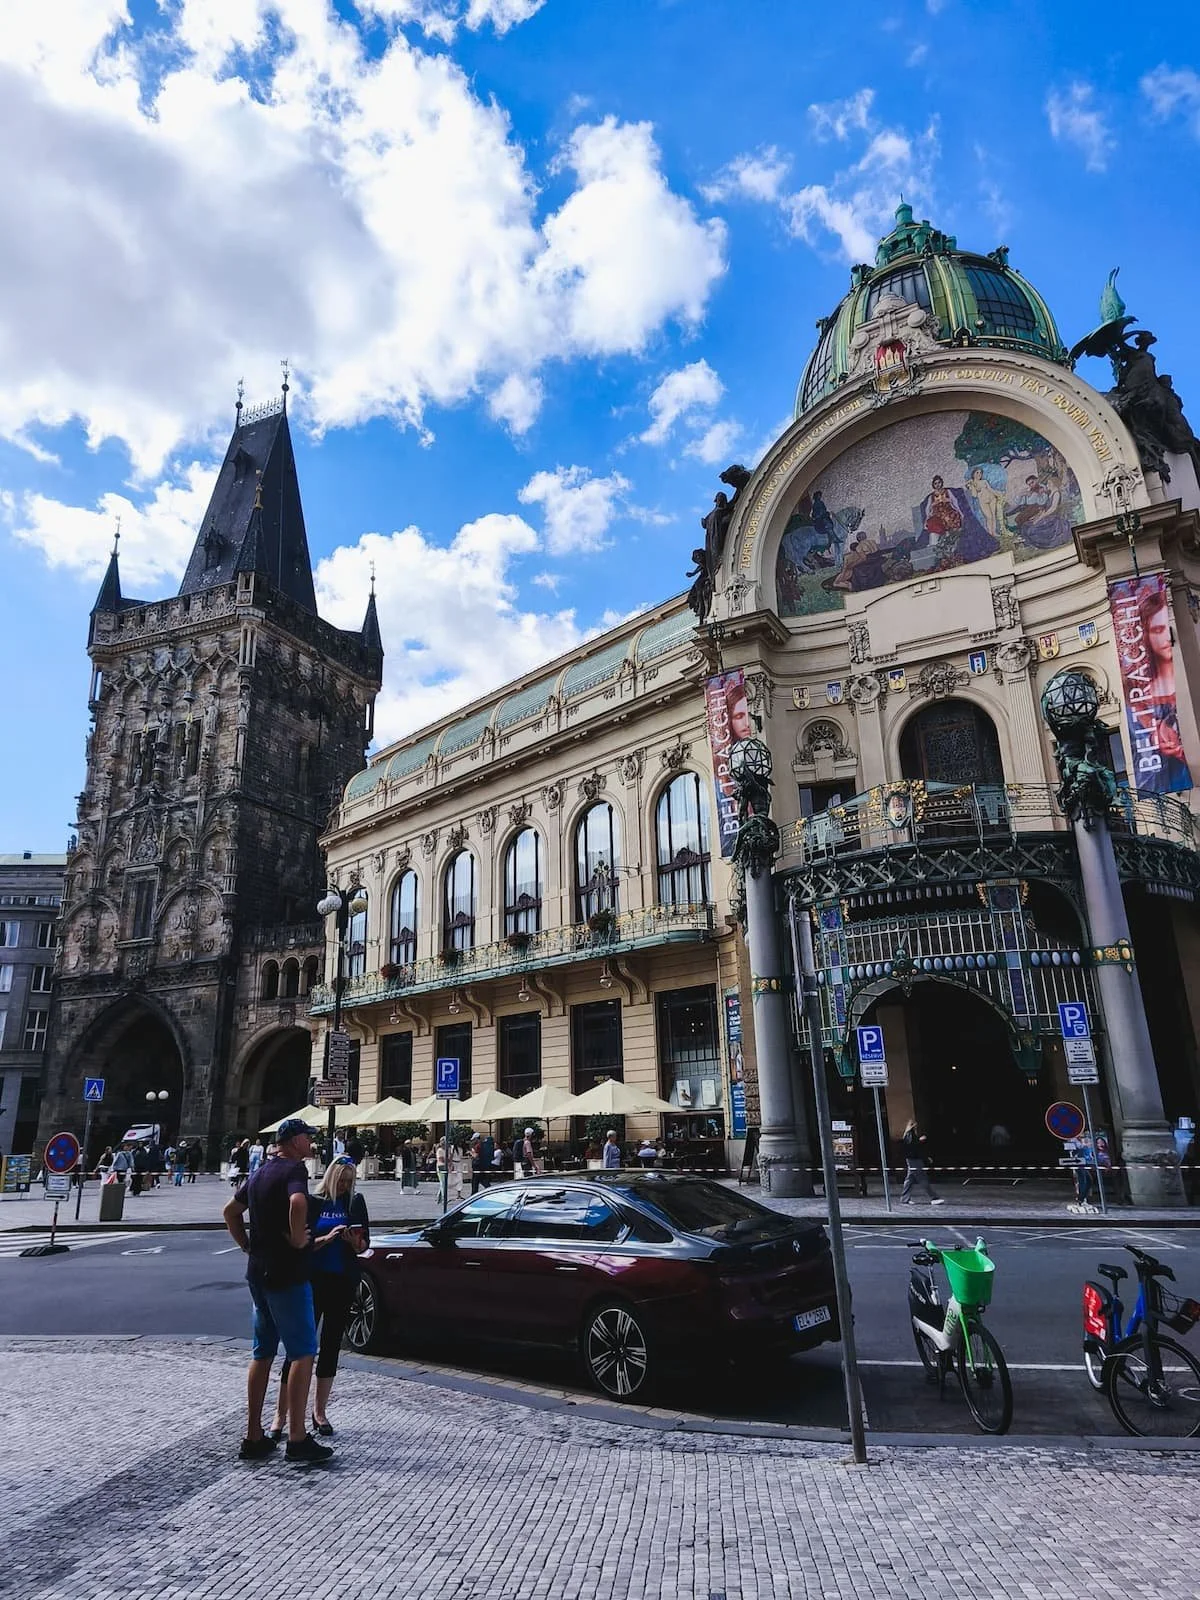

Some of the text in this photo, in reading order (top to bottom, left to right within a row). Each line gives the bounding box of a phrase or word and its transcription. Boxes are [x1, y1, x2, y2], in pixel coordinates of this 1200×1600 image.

[1115, 595, 1162, 773] BELTRACCHI
[1064, 1006, 1081, 1029] P
[862, 1030, 878, 1051] P
[441, 1062, 455, 1082] P
